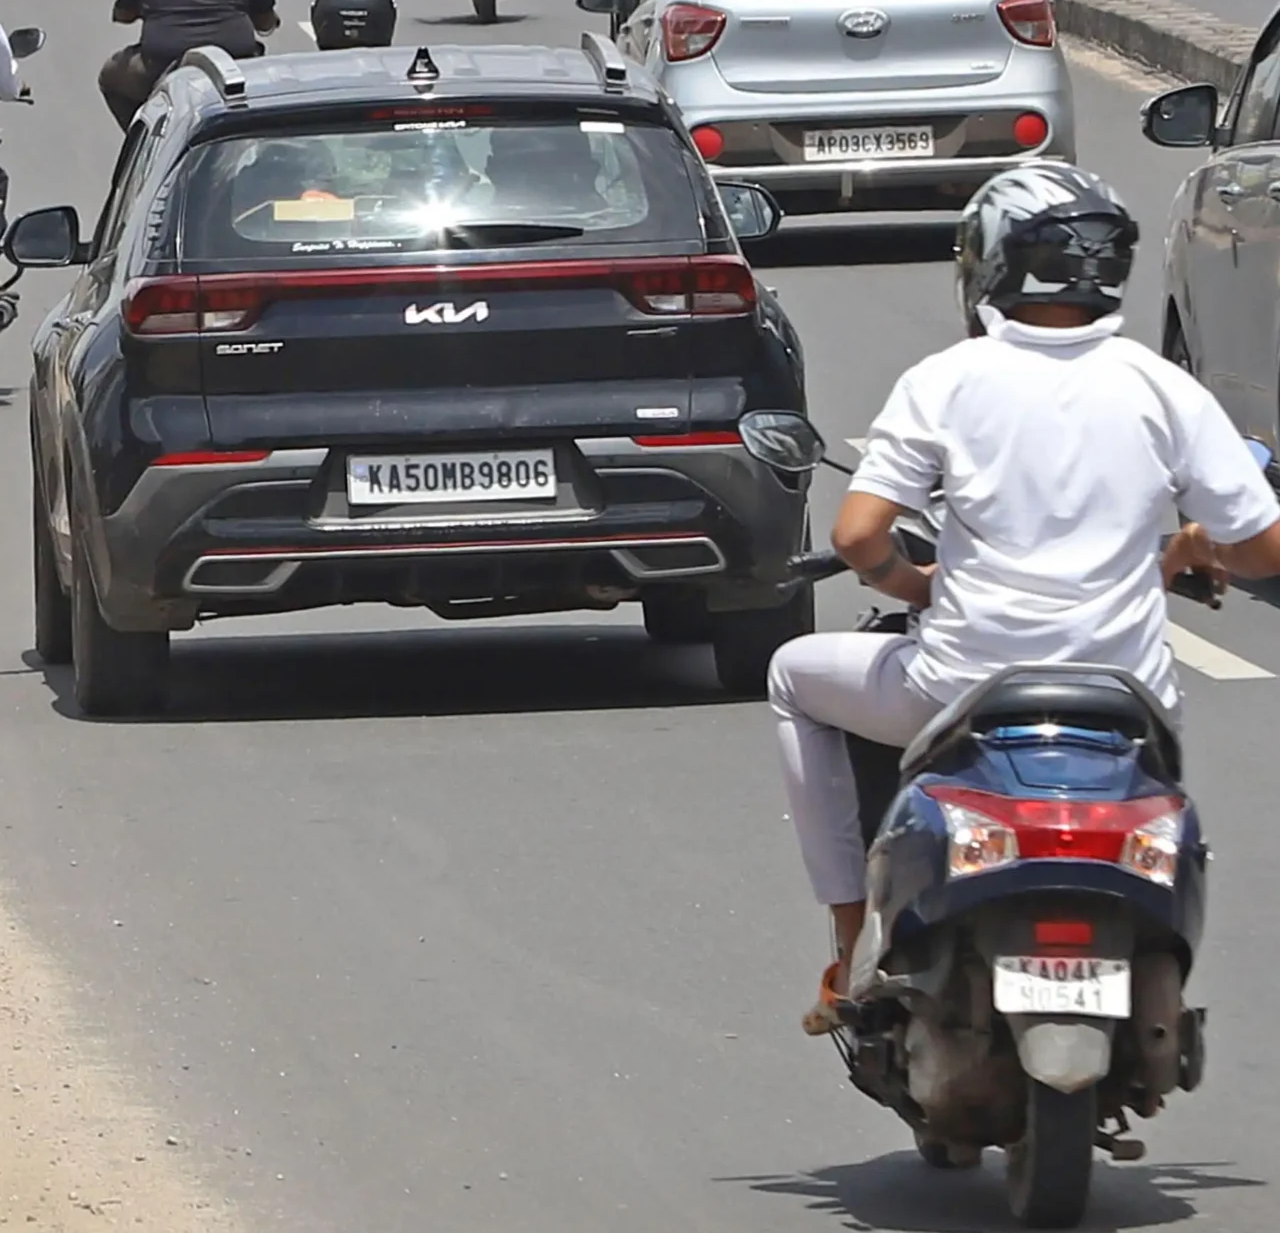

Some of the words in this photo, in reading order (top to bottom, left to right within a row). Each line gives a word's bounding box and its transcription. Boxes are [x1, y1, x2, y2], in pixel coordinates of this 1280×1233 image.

[817, 132, 930, 155] AP03CX3569
[405, 301, 489, 324] KIA
[215, 342, 284, 355] SONET
[368, 460, 549, 494] KA50MB9806
[1019, 956, 1102, 984] KA04K
